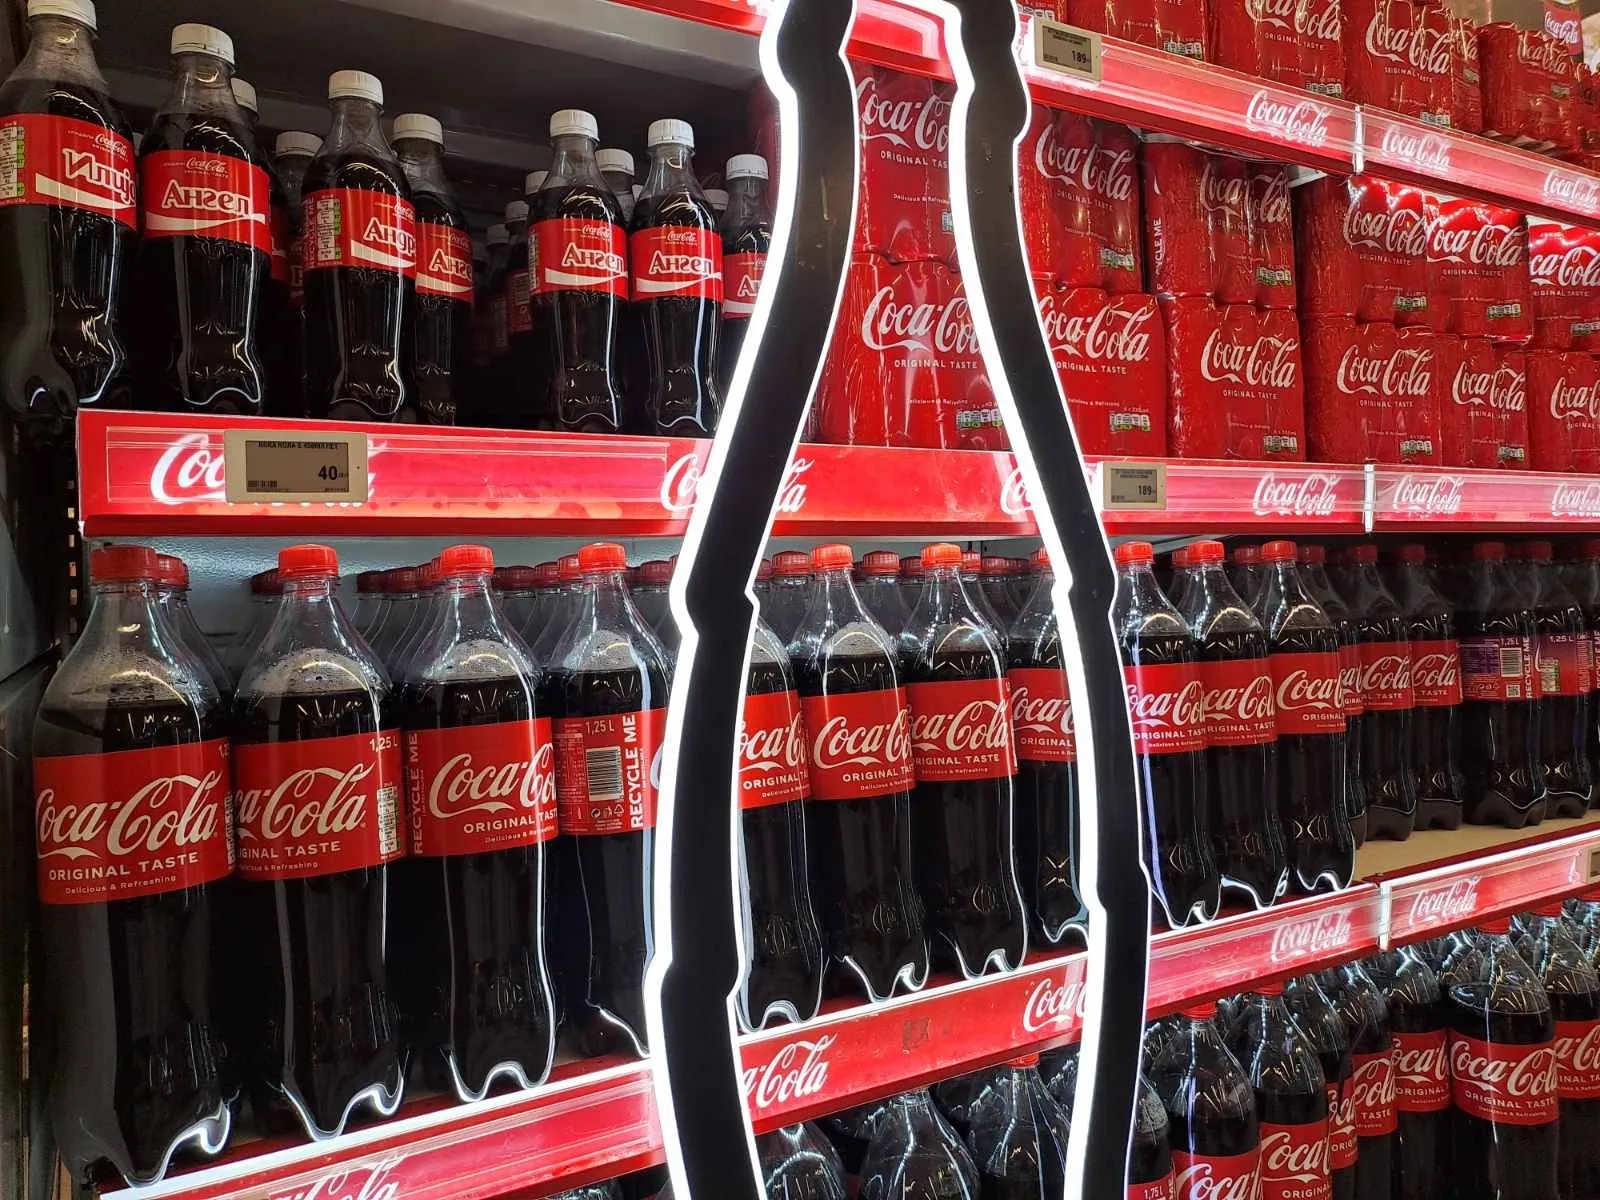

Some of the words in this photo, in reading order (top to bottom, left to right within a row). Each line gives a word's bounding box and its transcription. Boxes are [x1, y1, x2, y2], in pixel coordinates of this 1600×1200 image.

[1365, 10, 1450, 75] Coca-Cola
[856, 77, 950, 153] Coca-Co
[1245, 89, 1330, 147] Coca-Cola
[880, 150, 929, 166] ORIGINAL
[932, 157, 948, 169] TAS
[1035, 124, 1135, 201] Coca-Cola
[1382, 124, 1451, 171] Coca-Cola
[186, 157, 226, 172] Coca-Cola
[582, 224, 612, 238] Coca-Cola
[667, 231, 697, 242] Coca-Cola
[1343, 205, 1427, 256] Coca-Cola
[1427, 217, 1526, 267] Coca-Cola
[1530, 245, 1600, 287] ca-Col
[861, 286, 979, 354] Coca-Co
[1035, 295, 1151, 361] Coca-Cola
[894, 359, 946, 369] ORIGINAL
[950, 361, 978, 369] TASTE
[1056, 361, 1097, 374] ORIGINAL
[1101, 365, 1127, 375] TASTE
[1200, 327, 1298, 388] Coca-Cola
[1336, 344, 1434, 397] Coca-Cola
[1223, 389, 1255, 399] ORIGINAL
[1452, 360, 1526, 412] Coca-Cola
[1550, 376, 1600, 420] Coca-C
[318, 465, 338, 480] 40
[1138, 485, 1152, 496] 189
[1252, 472, 1341, 517] Coca-Cola
[1392, 473, 1465, 515] Coca-Cola
[1549, 635, 1567, 643] 1,25
[1524, 655, 1533, 699] RECYCLE
[1204, 675, 1276, 720] ca-Col
[1420, 689, 1448, 697] TASTE
[912, 700, 1009, 751] ca-Cola
[1012, 687, 1075, 734] Coca-C
[586, 720, 606, 734] 1,25
[608, 719, 614, 732] L
[622, 714, 637, 743] ME
[813, 708, 913, 769] Coca-Co
[1133, 732, 1185, 740] ORIGINAL
[1207, 724, 1251, 733] RIGINAL
[369, 735, 392, 752] 1,25
[393, 737, 398, 747] L
[408, 733, 419, 762] ME
[1020, 737, 1073, 747] ORIGINAL
[842, 770, 899, 783] ORIGINAL
[900, 764, 914, 776] TAS
[965, 753, 1000, 764] TASTE
[429, 742, 556, 819] Coca-Co
[625, 747, 644, 829] RECYCLE
[743, 774, 800, 790] ORIGINAL
[36, 770, 223, 859] Coca-Cola
[235, 761, 376, 840] ca-Cola
[410, 768, 424, 854] RECYCLE
[463, 816, 536, 834] ORIGINAL
[239, 847, 279, 860] IGINAL
[284, 840, 342, 857] TASTE
[49, 864, 131, 882] ORIGINAL
[138, 851, 199, 873] TASTE
[271, 861, 319, 872] Refreshing
[65, 885, 106, 895] Delicious
[120, 875, 177, 890] Refreshing
[1408, 875, 1483, 927] Coca-Cola
[1271, 910, 1351, 963] Coca-Cola
[743, 1033, 837, 1109] a-Cola
[1560, 1075, 1586, 1083] INAL
[1361, 1109, 1391, 1120] TASTE
[1465, 1090, 1522, 1109] ORIGINAL
[1331, 1141, 1354, 1152] ORIG
[1144, 1187, 1158, 1199] 1,75
